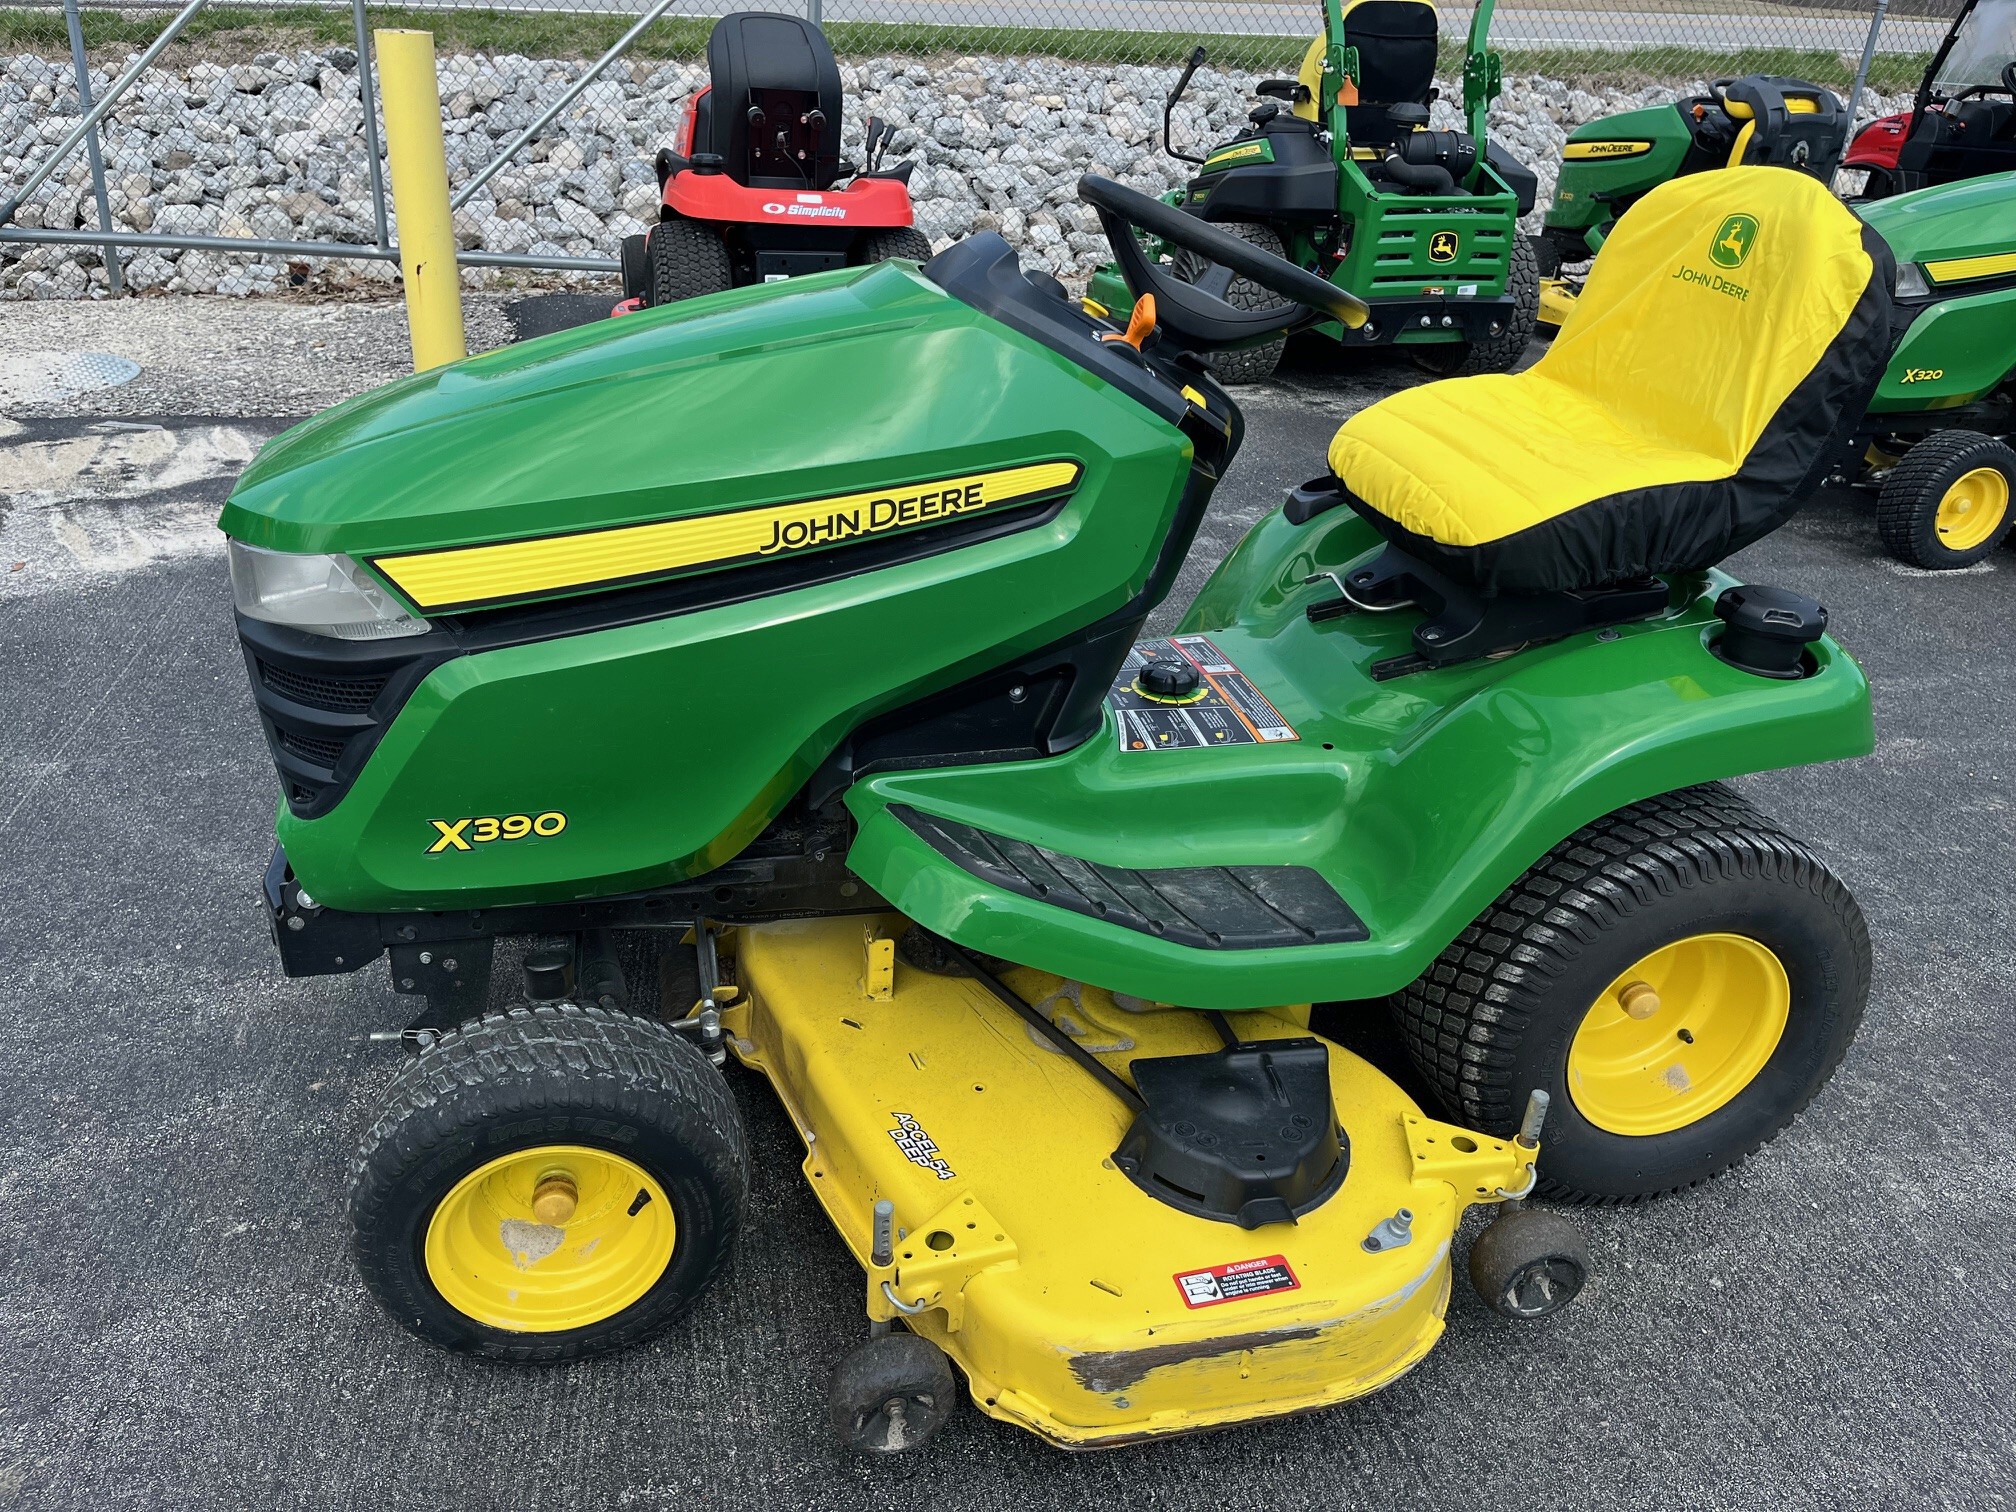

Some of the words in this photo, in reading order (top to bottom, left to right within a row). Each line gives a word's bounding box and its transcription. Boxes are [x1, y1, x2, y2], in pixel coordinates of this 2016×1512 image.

[1588, 144, 1607, 153] JOHN
[1607, 144, 1634, 153] DEERE
[787, 204, 847, 219] Simplicity
[1672, 265, 1712, 288] JOHN
[1712, 275, 1750, 302] DEERE
[1900, 368, 1944, 384] X320
[760, 510, 859, 551] JOHN
[870, 483, 983, 528] DEERE
[423, 810, 568, 854] X390
[887, 1128, 931, 1167] DEEP
[890, 1111, 940, 1160] ACCEL
[929, 1158, 957, 1180] 54
[1222, 1271, 1255, 1281] ROTATING
[1255, 1268, 1276, 1276] BLADE
[1234, 1260, 1268, 1271] DANGER
